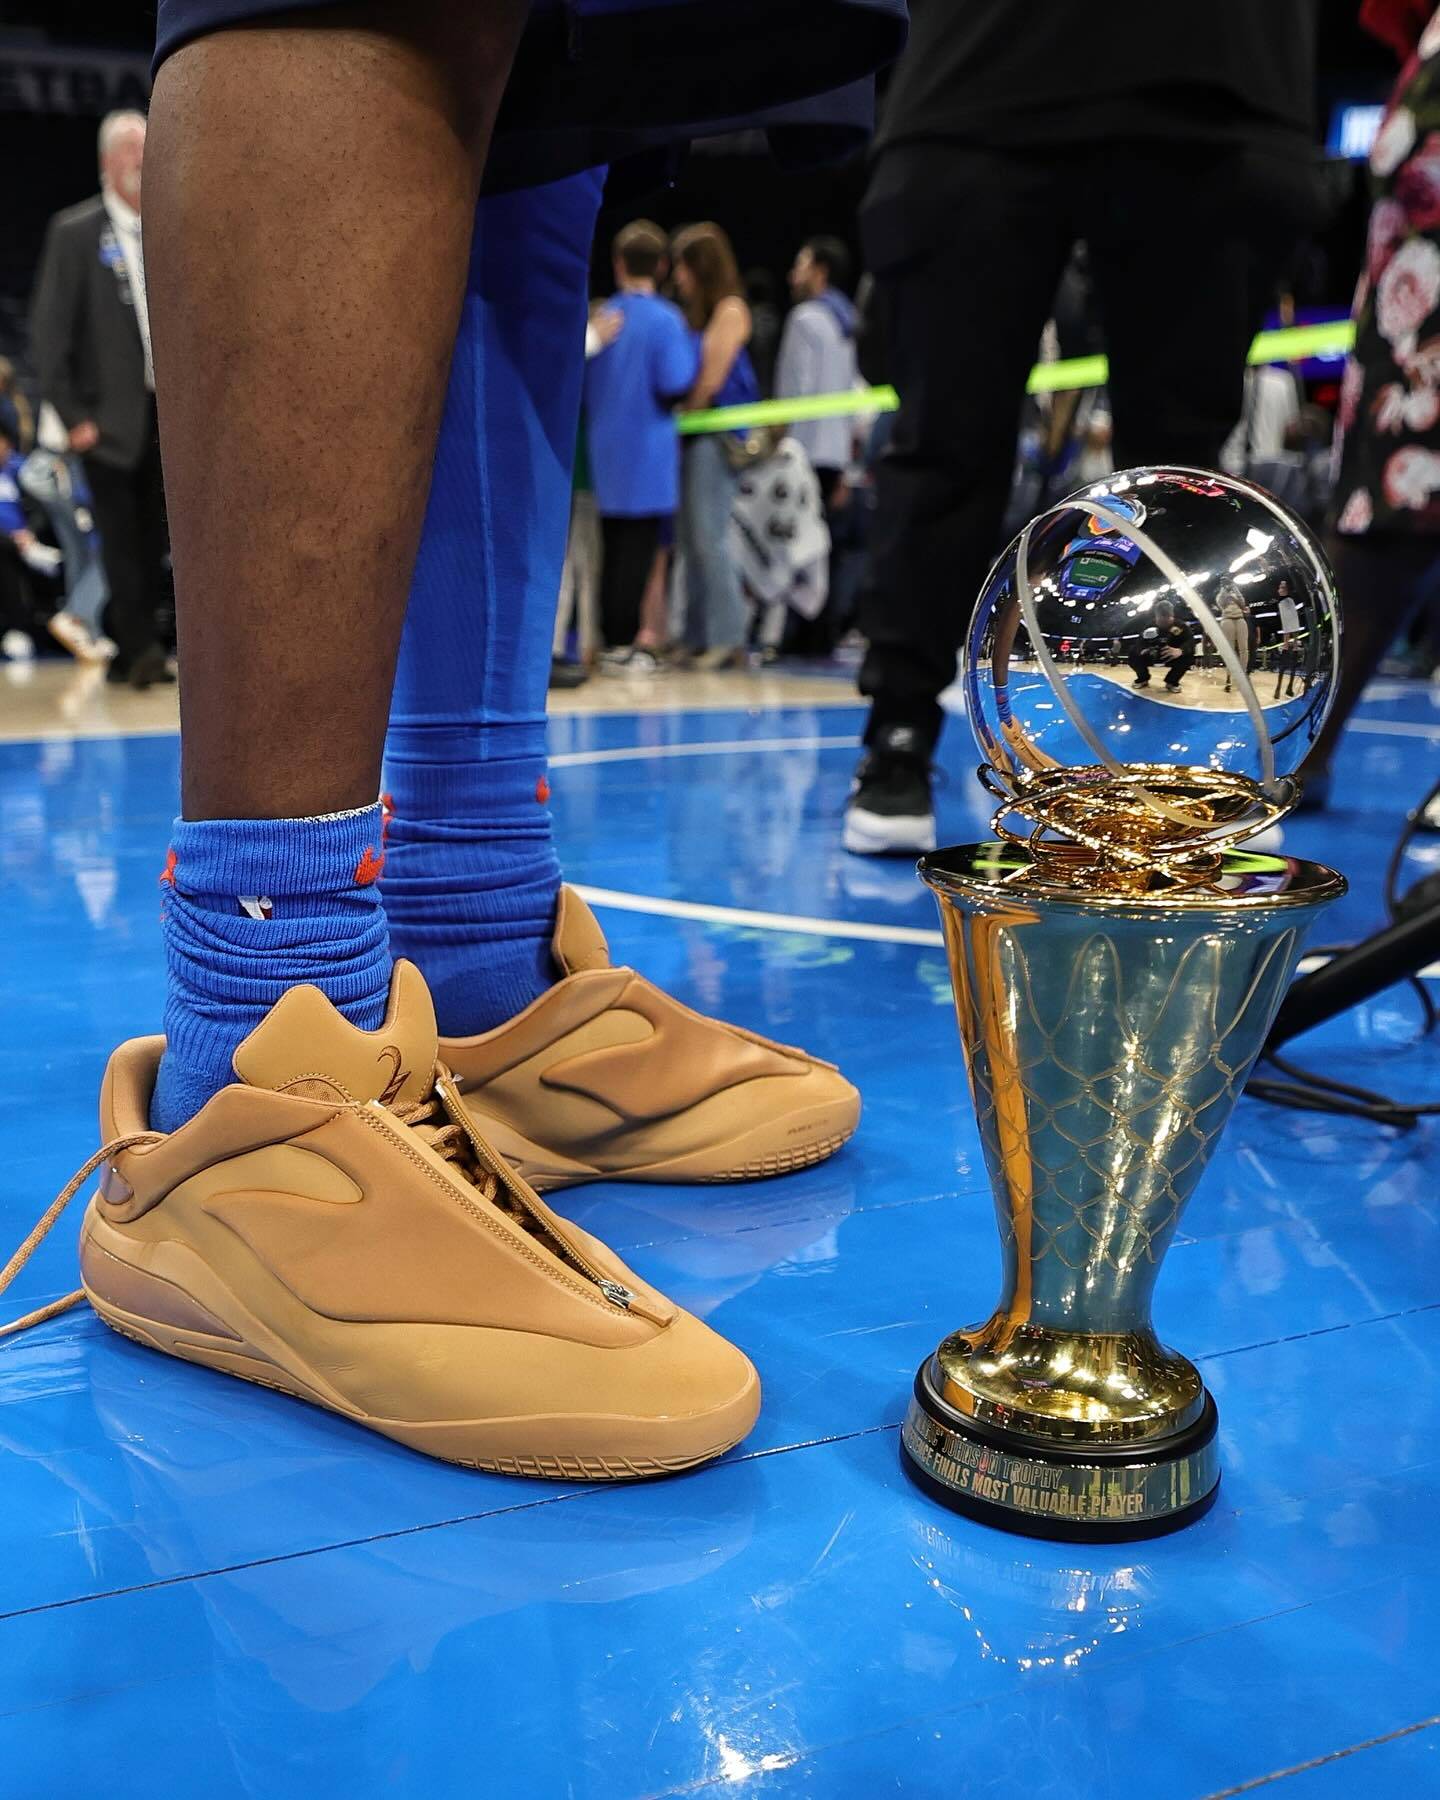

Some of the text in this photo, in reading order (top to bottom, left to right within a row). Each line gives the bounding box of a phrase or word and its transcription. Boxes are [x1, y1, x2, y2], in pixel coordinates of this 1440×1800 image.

[933, 1452, 1144, 1516] FINALS MOST VALUABLE PLAYER
[942, 1434, 999, 1476] JOHNSON
[1003, 1457, 1063, 1489] TROPHY
